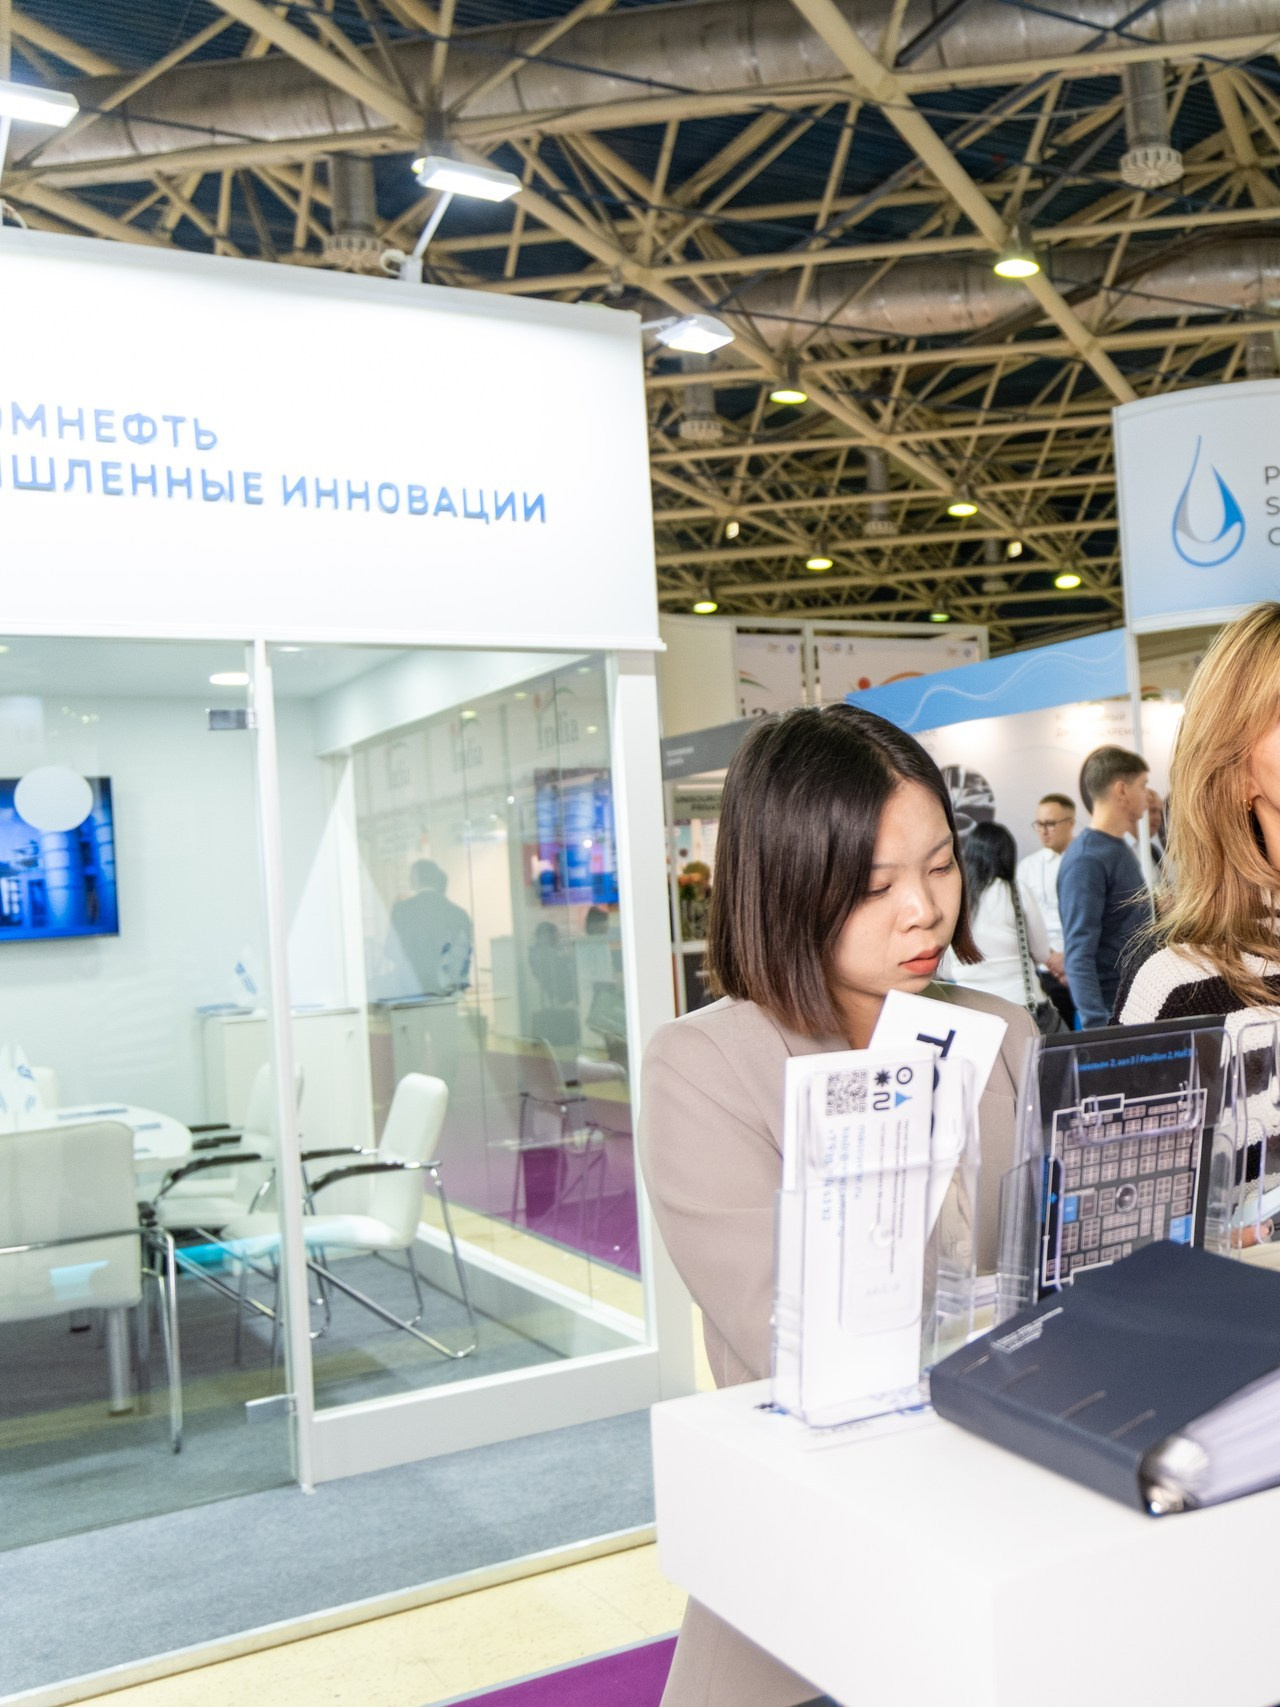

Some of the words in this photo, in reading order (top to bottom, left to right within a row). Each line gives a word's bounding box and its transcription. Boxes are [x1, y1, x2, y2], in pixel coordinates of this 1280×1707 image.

[0, 400, 218, 451] МНЕФТЬ
[0, 454, 263, 505] ШЛЕННЫЕ
[281, 474, 546, 525] ИННОВАЦИИ
